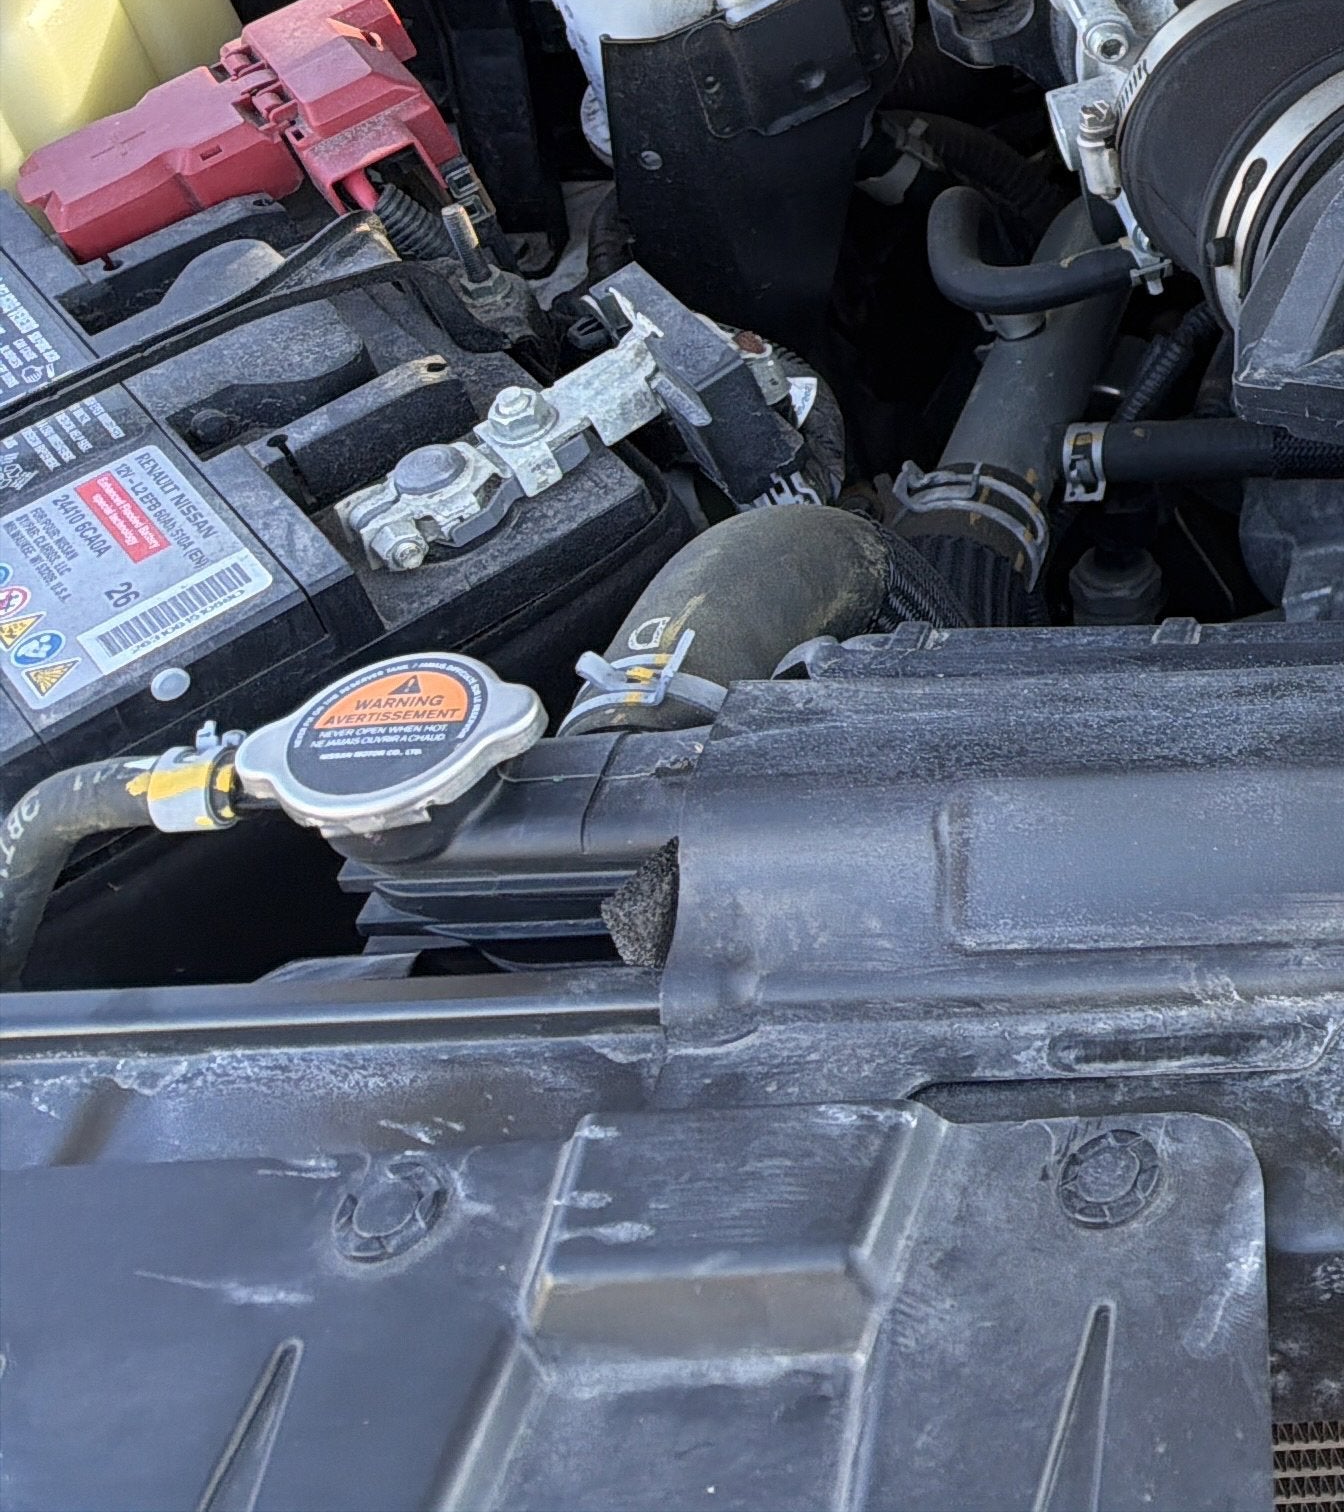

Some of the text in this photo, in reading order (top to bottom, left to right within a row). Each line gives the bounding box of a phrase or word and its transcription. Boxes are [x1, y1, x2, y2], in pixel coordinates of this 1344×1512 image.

[114, 463, 133, 478] 12V
[139, 493, 161, 511] EFB
[169, 528, 193, 549] 510A
[135, 452, 216, 539] RENAULT NISSAN
[52, 494, 85, 524] 24410
[105, 581, 139, 607] 26
[354, 695, 445, 711] WARNING
[323, 708, 461, 727] AVERTISSEMENT
[318, 729, 355, 738] NEVER
[355, 726, 386, 735] OPEN
[388, 724, 422, 734] WHEN
